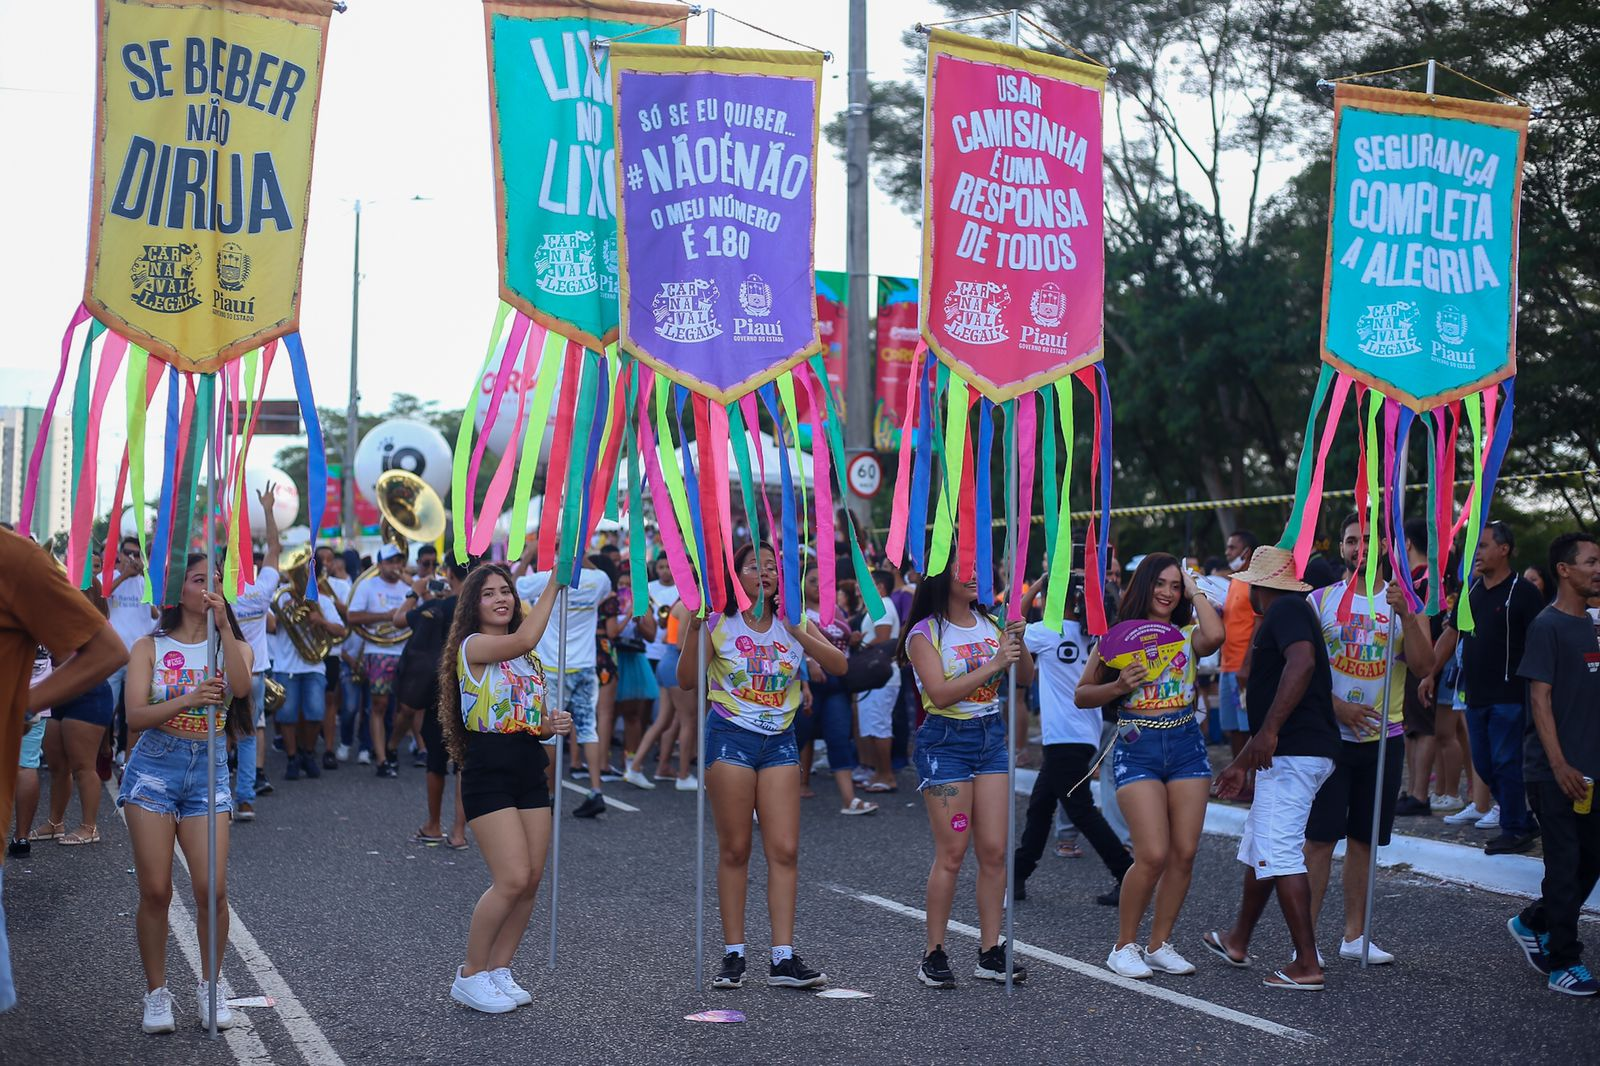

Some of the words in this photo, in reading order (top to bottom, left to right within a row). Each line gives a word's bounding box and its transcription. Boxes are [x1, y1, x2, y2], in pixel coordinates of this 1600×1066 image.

[121, 39, 174, 101] SE
[184, 36, 306, 122] BEBER
[996, 74, 1042, 109] USAR
[185, 98, 231, 147] NÃO
[576, 101, 601, 146] NO
[638, 103, 663, 133] SÓ
[669, 102, 690, 126] SE
[696, 98, 718, 123] EU
[723, 101, 796, 137] QUISER...
[951, 108, 1088, 174] CAMISINHA
[627, 132, 809, 200] #NÃOÉNÃO
[989, 147, 1003, 179] É
[1004, 156, 1049, 185] UMA
[1354, 132, 1500, 190] SEGURANÇA
[110, 134, 293, 234] DIRIJA
[950, 171, 1088, 229] RESPONSA
[650, 207, 664, 230] O
[667, 197, 706, 227] MEU
[709, 194, 781, 233] NÚMERO
[1348, 179, 1494, 242] COMPLETA
[682, 225, 699, 261] É
[703, 225, 751, 260] 180
[956, 221, 993, 265] DE
[997, 232, 1076, 272] TODOS
[1340, 236, 1364, 270] A
[1361, 240, 1500, 295] ALEGRIA
[212, 289, 255, 314] Piauí
[733, 318, 783, 337] Piauí
[1020, 325, 1068, 348] Piauí
[1050, 347, 1067, 355] ESTADO
[1431, 340, 1475, 364] Piauí
[858, 464, 876, 479] 60
[1335, 656, 1386, 677] LEGAL
